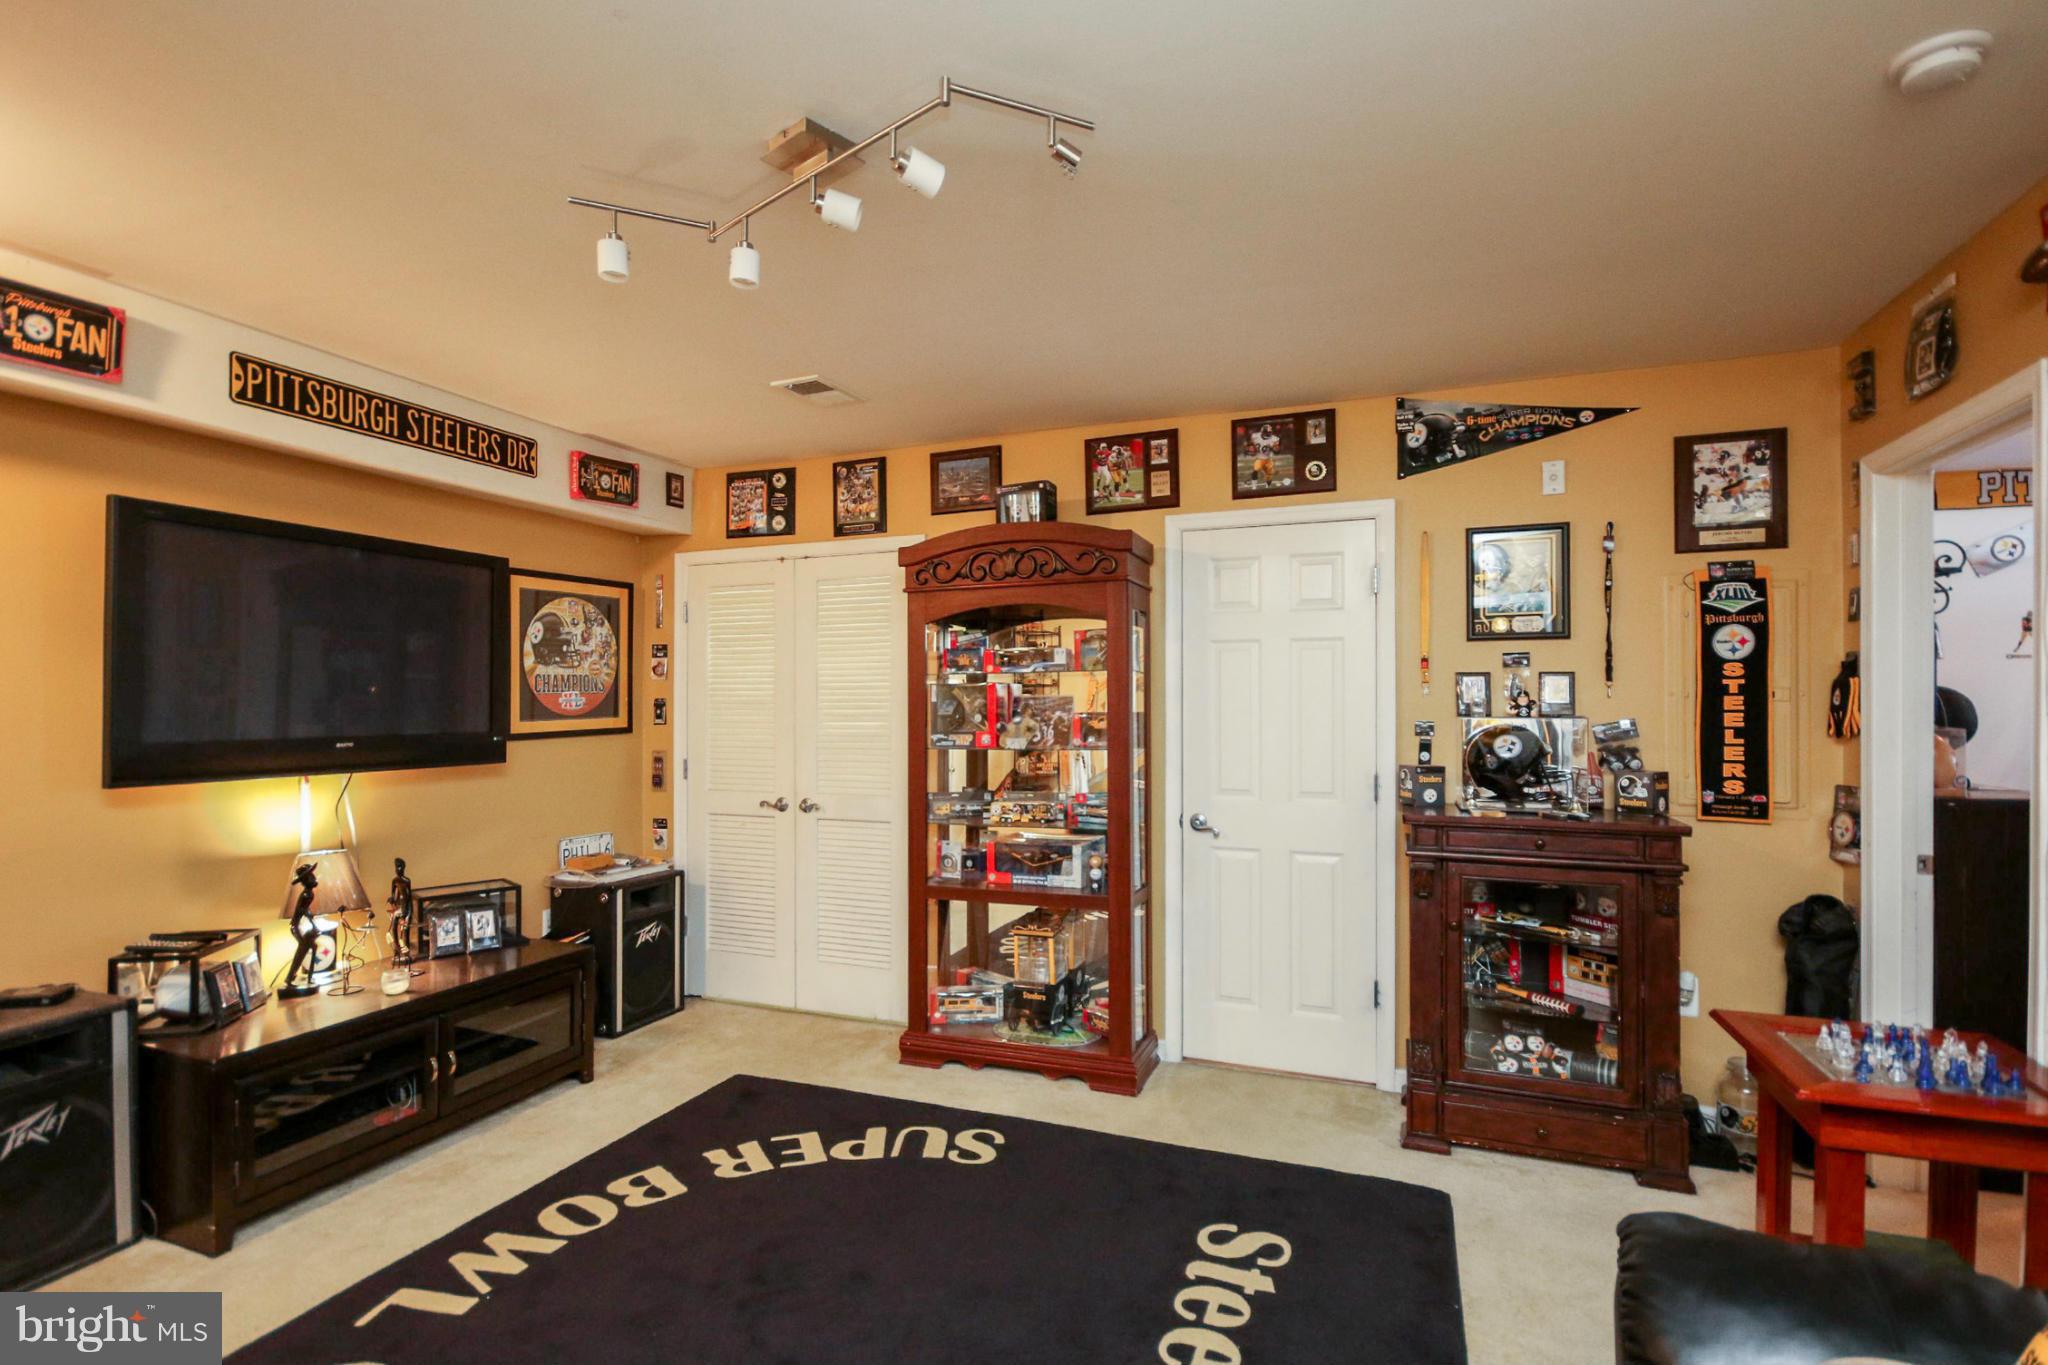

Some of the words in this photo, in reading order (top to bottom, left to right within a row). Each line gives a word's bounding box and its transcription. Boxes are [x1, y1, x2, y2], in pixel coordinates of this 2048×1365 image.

[4, 291, 71, 319] Pittsburgh
[12, 335, 63, 360] Steelers
[55, 317, 107, 358] FAN
[246, 362, 398, 437] PITTSBURGH
[406, 409, 501, 464] STEELERS
[507, 438, 531, 471] DR
[1479, 414, 1577, 442] CHAMPIONS
[611, 471, 632, 494] FAN
[1977, 470, 2033, 504] PIT
[1705, 613, 1765, 626] Pittsburgh
[534, 673, 605, 693] CHAMPIONS
[1722, 661, 1746, 795] STEELERS
[702, 1126, 1006, 1178] SUPER
[354, 1165, 688, 1328] BOWL
[1157, 1223, 1292, 1365] Stee
